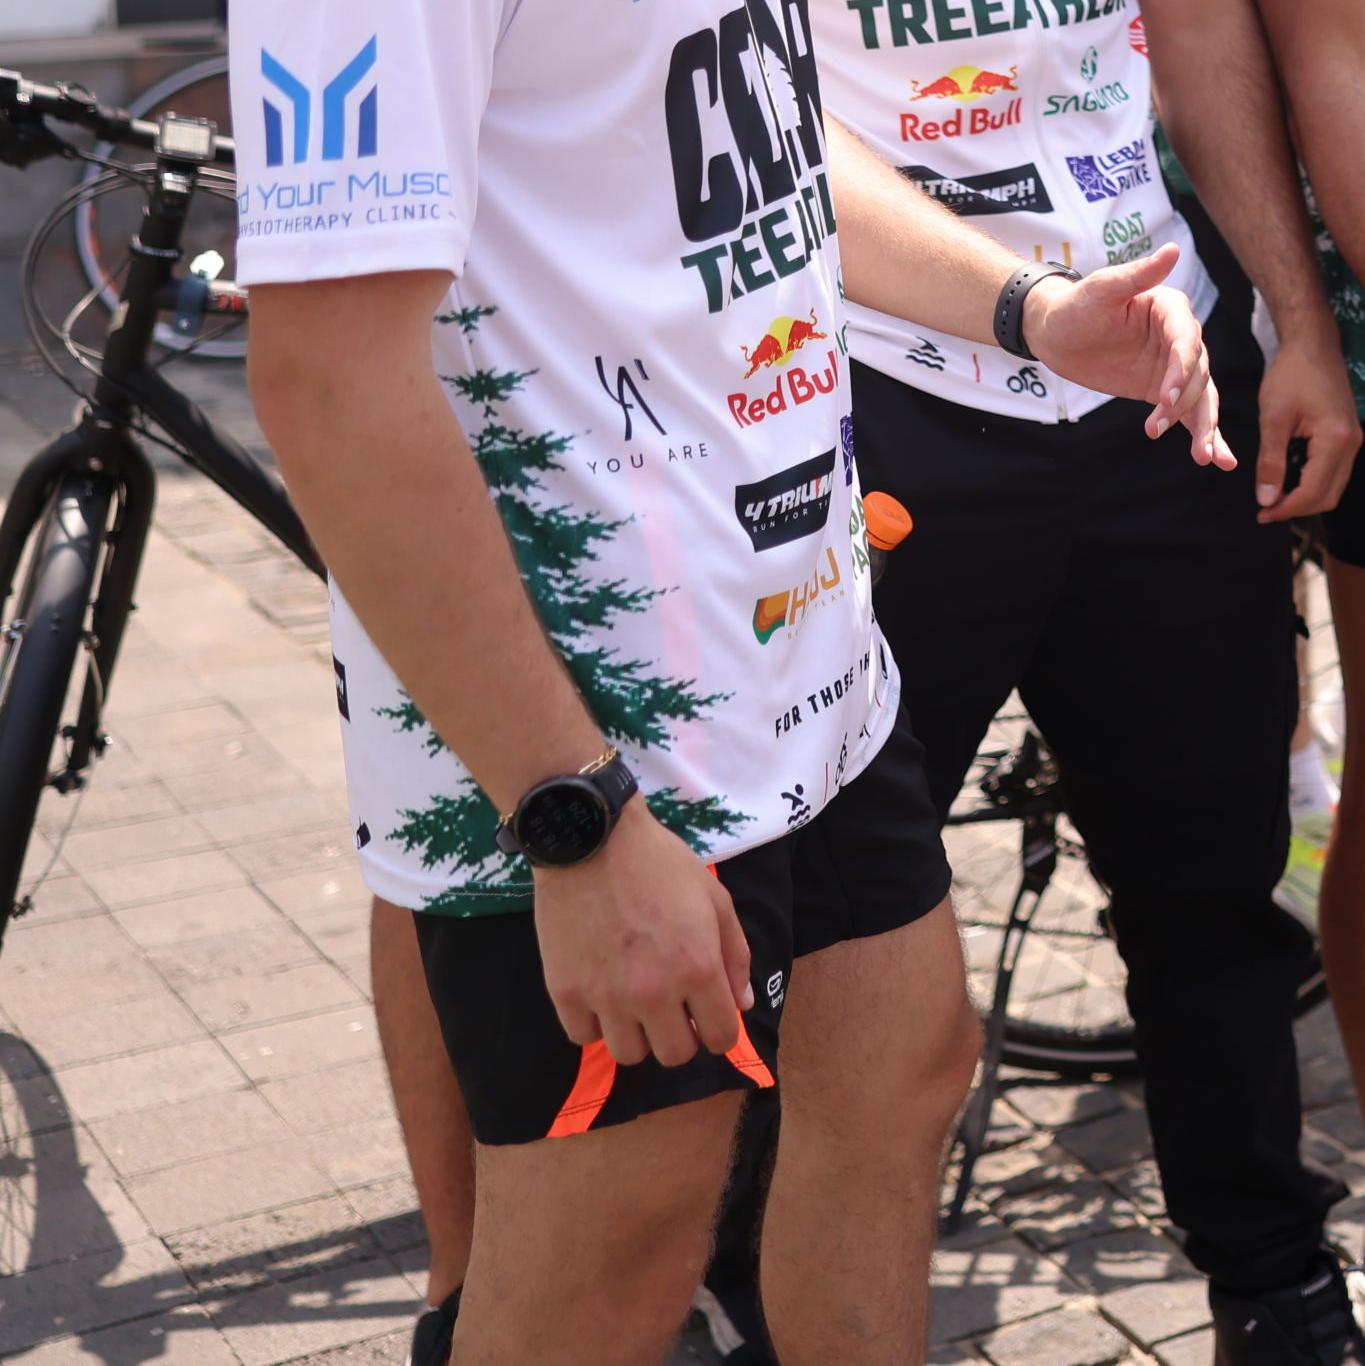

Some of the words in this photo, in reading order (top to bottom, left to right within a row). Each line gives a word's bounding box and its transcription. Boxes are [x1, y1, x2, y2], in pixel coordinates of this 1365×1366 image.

[899, 108, 962, 142] Red
[970, 97, 1023, 135] Bull
[257, 181, 336, 212] Your
[366, 203, 441, 225] CLINIC
[727, 375, 788, 429] Red
[586, 453, 645, 475] YOU
[668, 443, 709, 463] ARE
[753, 520, 776, 534] RUN
[785, 507, 808, 524] FOR
[775, 704, 803, 739] FOR
[807, 665, 854, 715] THOSE
